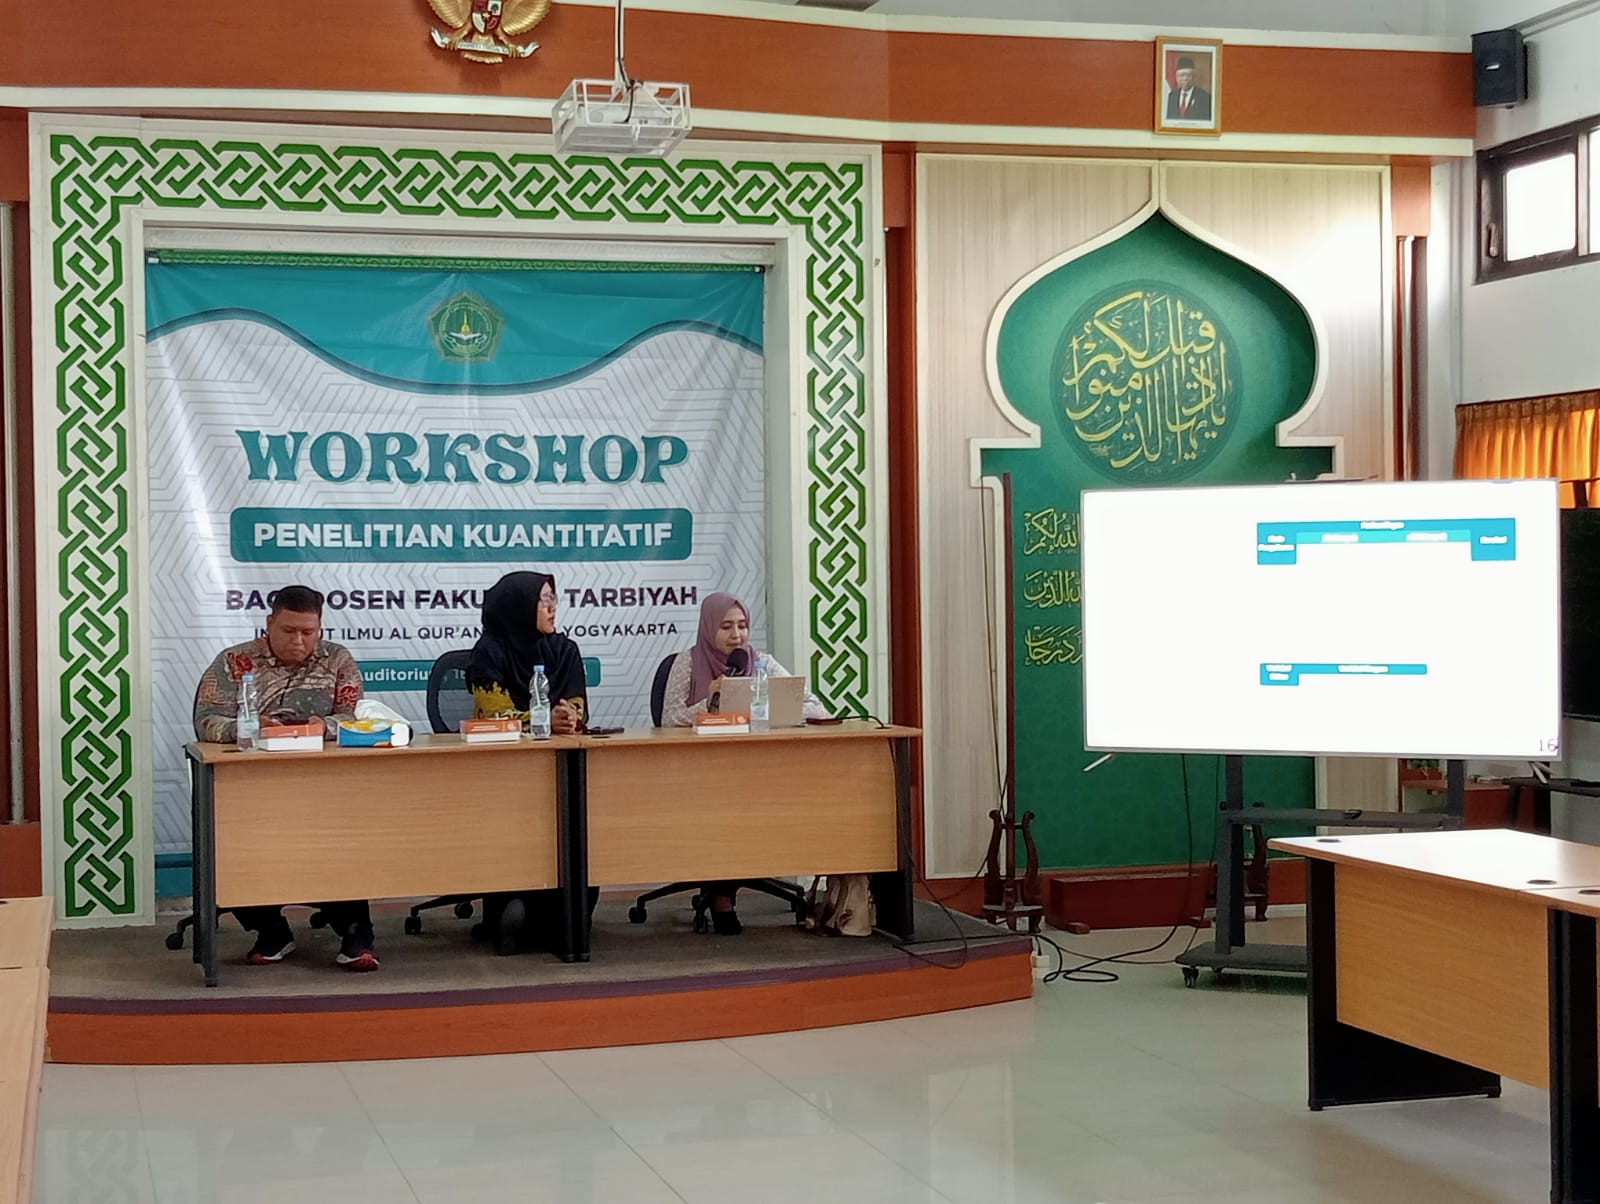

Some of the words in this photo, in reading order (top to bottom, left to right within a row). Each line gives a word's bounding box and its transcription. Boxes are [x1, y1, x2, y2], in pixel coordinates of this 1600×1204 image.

[237, 430, 689, 484] WORKSHOP
[254, 523, 455, 548] PENELITIAN
[463, 522, 672, 547] KUANTITATIF
[226, 590, 276, 610] BA
[318, 590, 406, 610] OSEN
[564, 586, 697, 608] TARBIYAH
[342, 628, 382, 640] ILMU
[390, 628, 409, 640] AL
[563, 623, 678, 637] YOGYAKARTA
